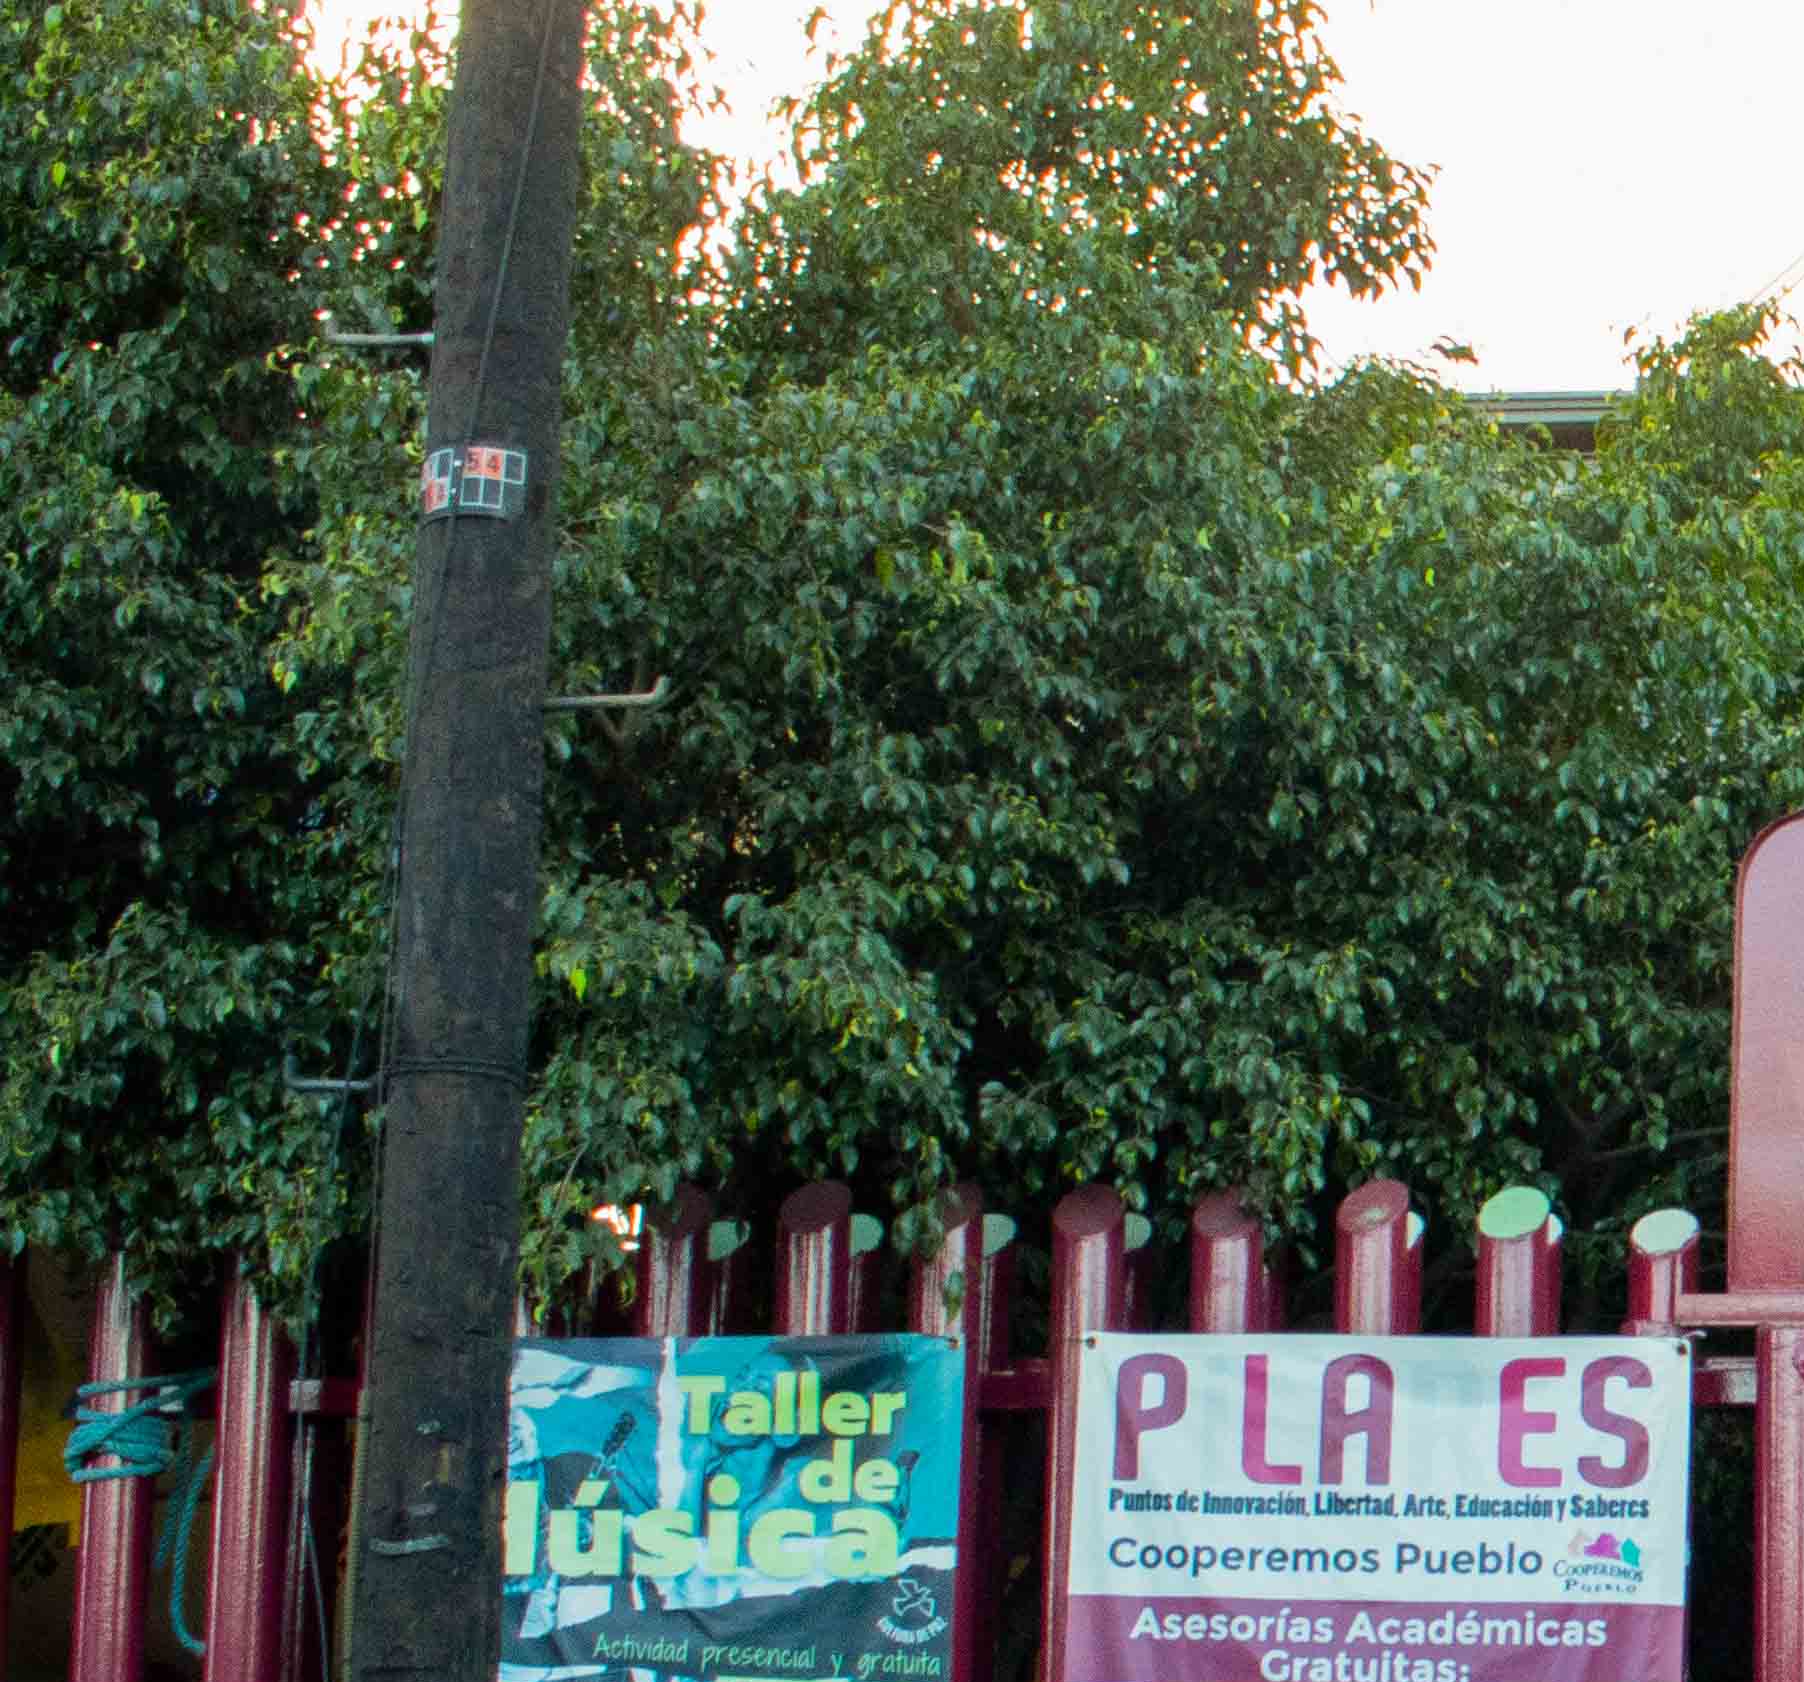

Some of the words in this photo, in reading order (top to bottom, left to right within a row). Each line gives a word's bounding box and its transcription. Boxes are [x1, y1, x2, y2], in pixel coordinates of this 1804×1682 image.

[680, 1371, 907, 1435] Taller
[800, 1440, 899, 1503] de
[1109, 1487, 1173, 1513] Puntos
[1175, 1489, 1200, 1513] de
[1202, 1490, 1311, 1517] Innovación,
[1314, 1491, 1399, 1518] Libertad,
[1403, 1493, 1451, 1519] Arte,
[1455, 1493, 1553, 1519] Educación
[1554, 1500, 1566, 1523] y
[1570, 1494, 1650, 1519] Saberes
[1109, 1537, 1380, 1578] Cooperemos
[1396, 1541, 1543, 1575] Pueblo
[1128, 1607, 1334, 1644] Asesorías
[1344, 1609, 1607, 1647] Académicas
[592, 1631, 690, 1663] Actividad
[700, 1644, 816, 1673] presencial
[831, 1653, 842, 1676] y
[857, 1649, 941, 1681] gratuita
